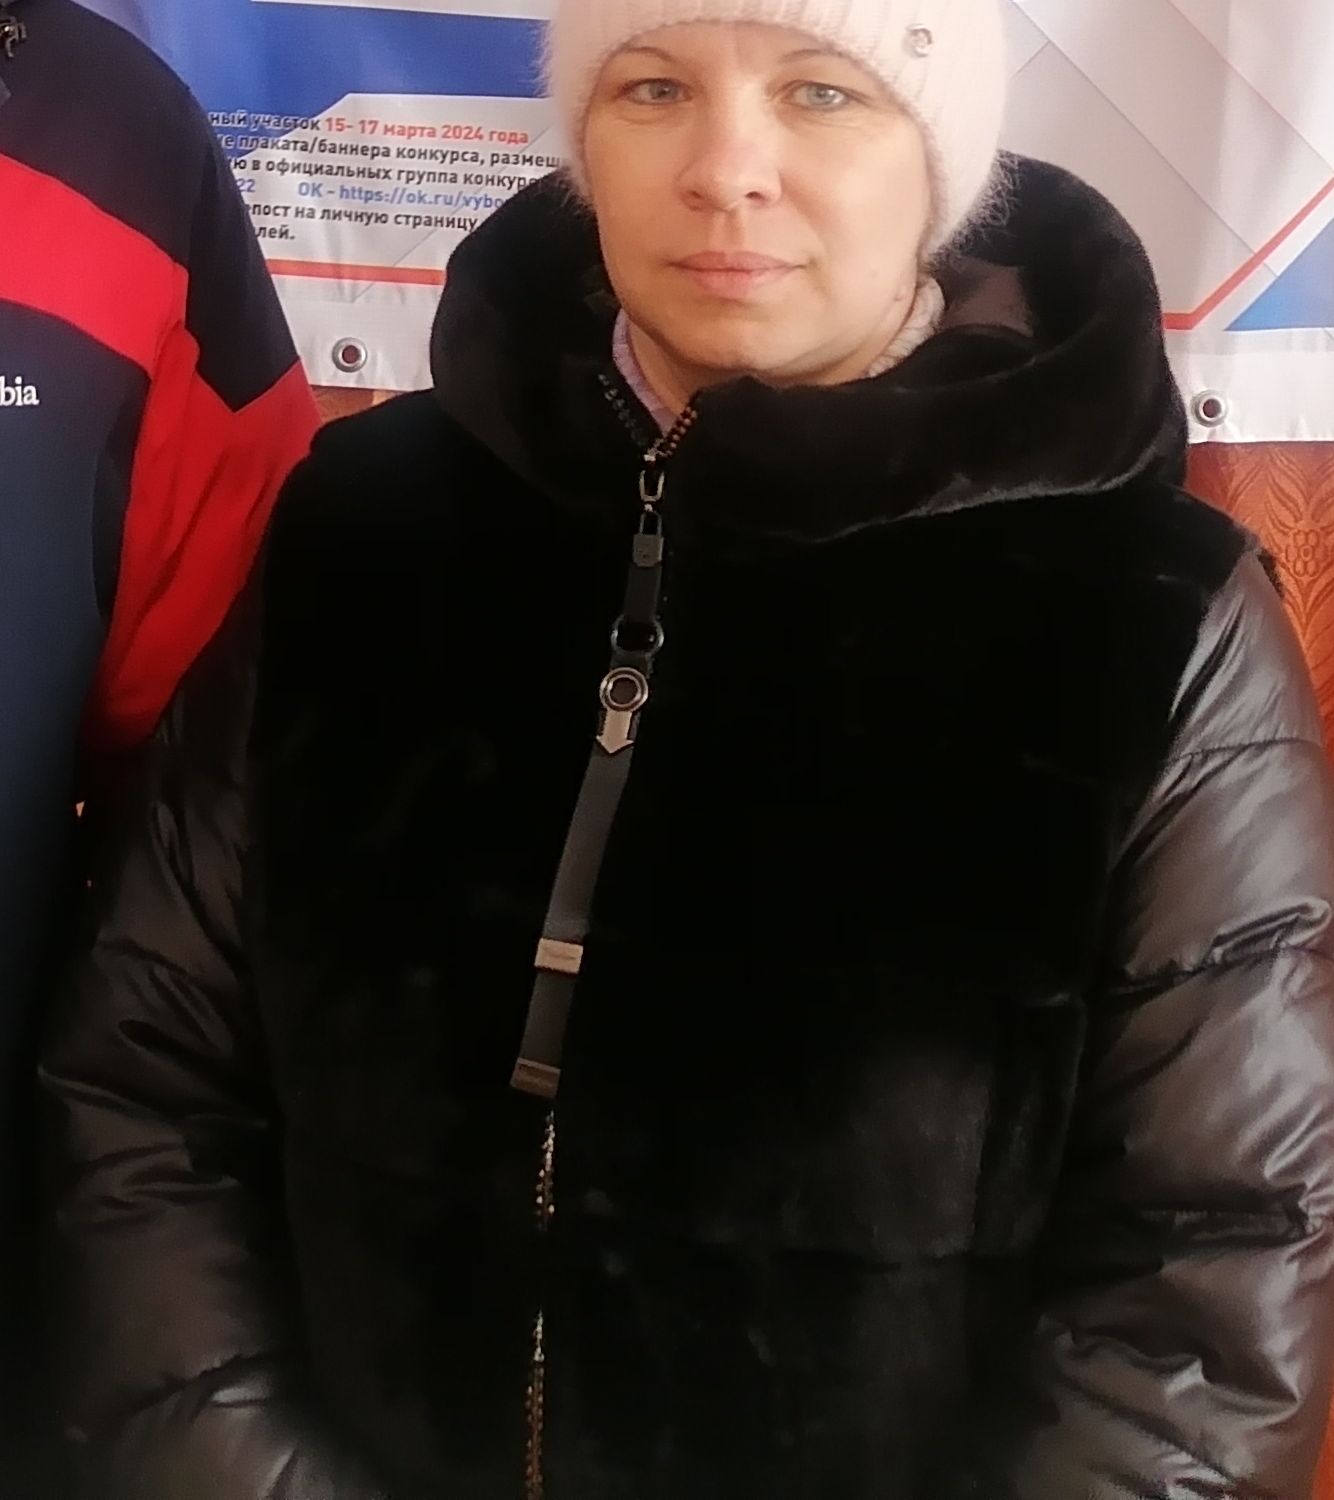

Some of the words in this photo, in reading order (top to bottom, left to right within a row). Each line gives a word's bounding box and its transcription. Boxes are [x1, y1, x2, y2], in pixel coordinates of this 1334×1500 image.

[210, 110, 247, 128] ный
[252, 113, 320, 130] участок
[359, 119, 379, 135] 17
[383, 123, 436, 140] марта
[442, 125, 484, 140] 2024
[489, 130, 529, 144] года
[396, 146, 485, 166] конкурса,
[252, 159, 261, 170] в
[266, 157, 392, 179] официальных
[397, 167, 458, 185] группа
[236, 178, 256, 193] 22
[340, 185, 505, 211] https://ok.ru/vybo
[248, 203, 291, 218] пост
[294, 207, 315, 219] на
[319, 208, 388, 226] личную
[256, 225, 296, 240] лей.
